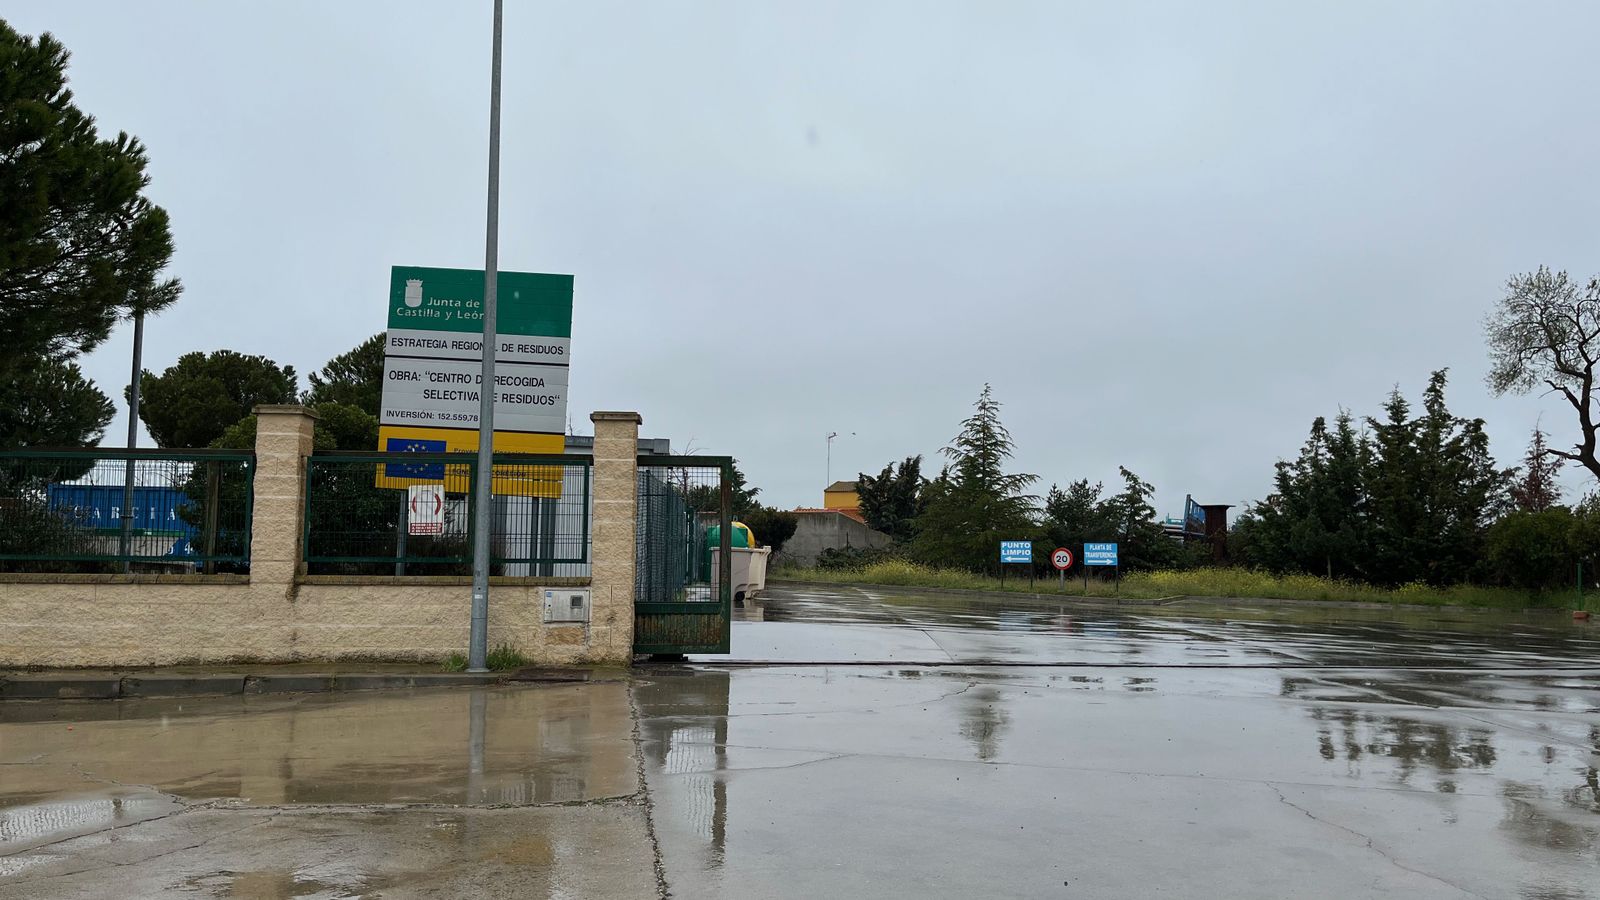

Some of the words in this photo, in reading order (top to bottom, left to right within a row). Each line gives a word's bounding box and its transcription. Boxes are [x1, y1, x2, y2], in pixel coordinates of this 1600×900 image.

[428, 297, 461, 307] Junta
[466, 299, 480, 308] de
[397, 308, 440, 318] Castilla
[445, 311, 452, 320] y
[391, 337, 448, 349] ESTRATEGIA
[501, 343, 514, 352] DE
[517, 344, 564, 355] RESIDUOS
[389, 370, 421, 382] OBRA:
[475, 375, 483, 384] D
[494, 376, 545, 388] RECOGIDA
[423, 389, 480, 401] SELECTIVA
[386, 410, 435, 419] INVERSIÓN:
[437, 413, 479, 422] 152.559,78
[1056, 555, 1068, 563] 20
